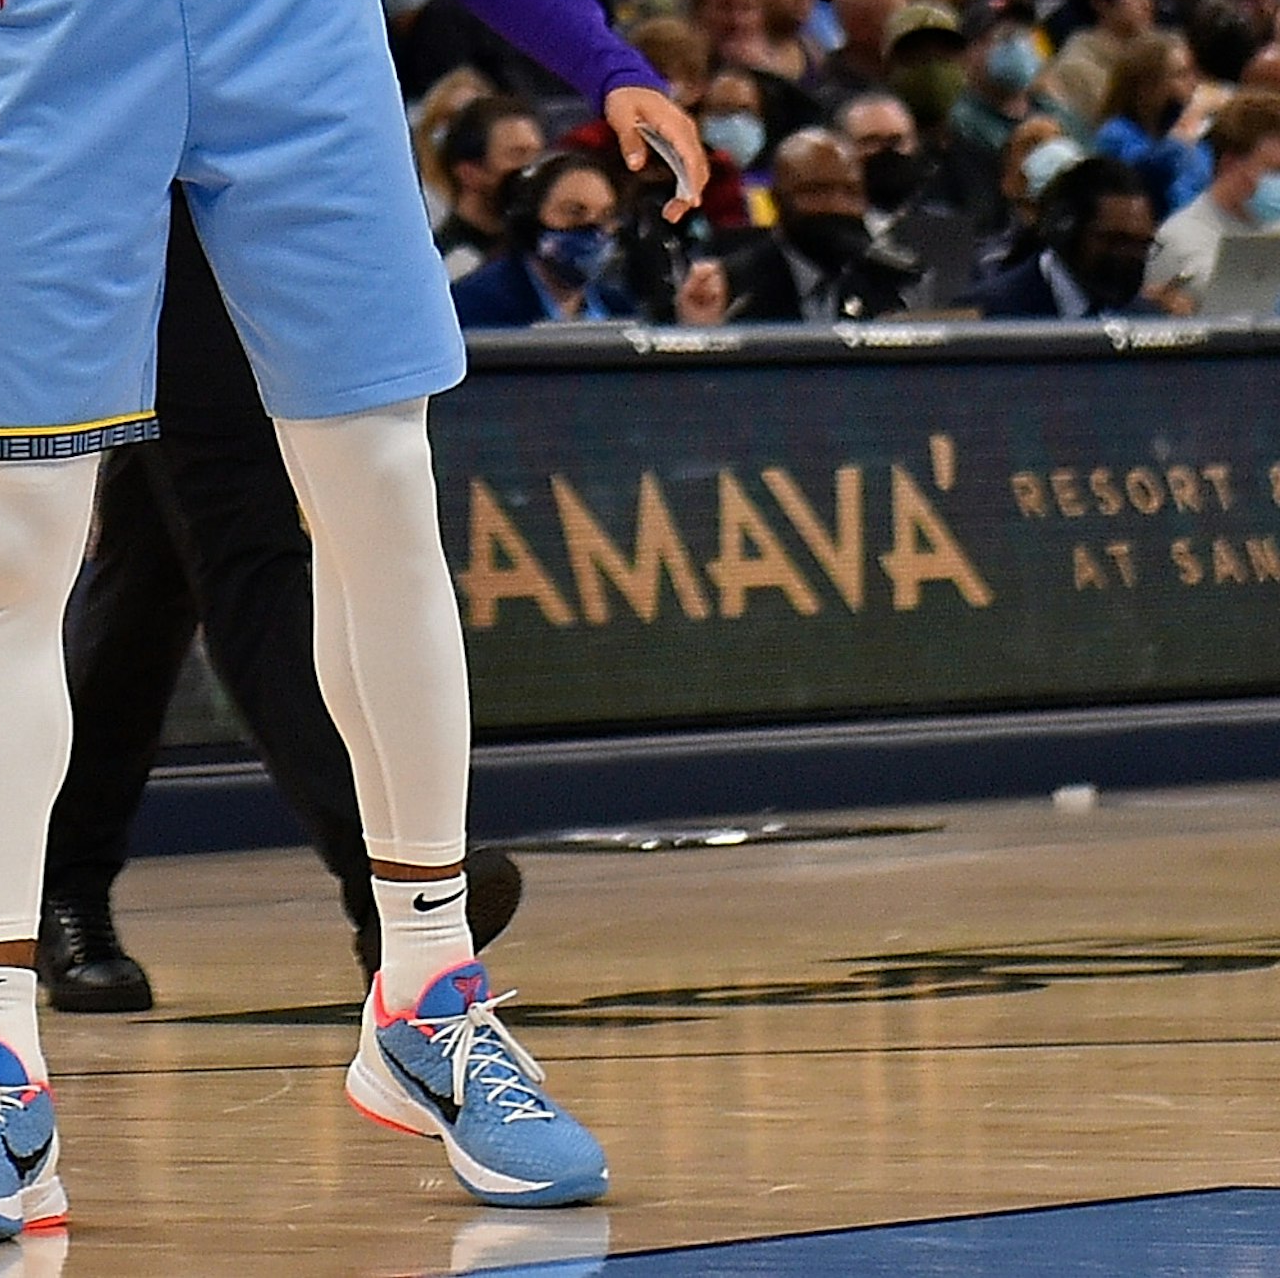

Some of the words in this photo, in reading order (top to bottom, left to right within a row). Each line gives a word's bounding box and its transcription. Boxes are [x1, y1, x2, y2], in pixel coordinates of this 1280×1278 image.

[1010, 464, 1231, 517] RESORT
[1072, 540, 1138, 591] AT
[1170, 535, 1280, 585] SAN
